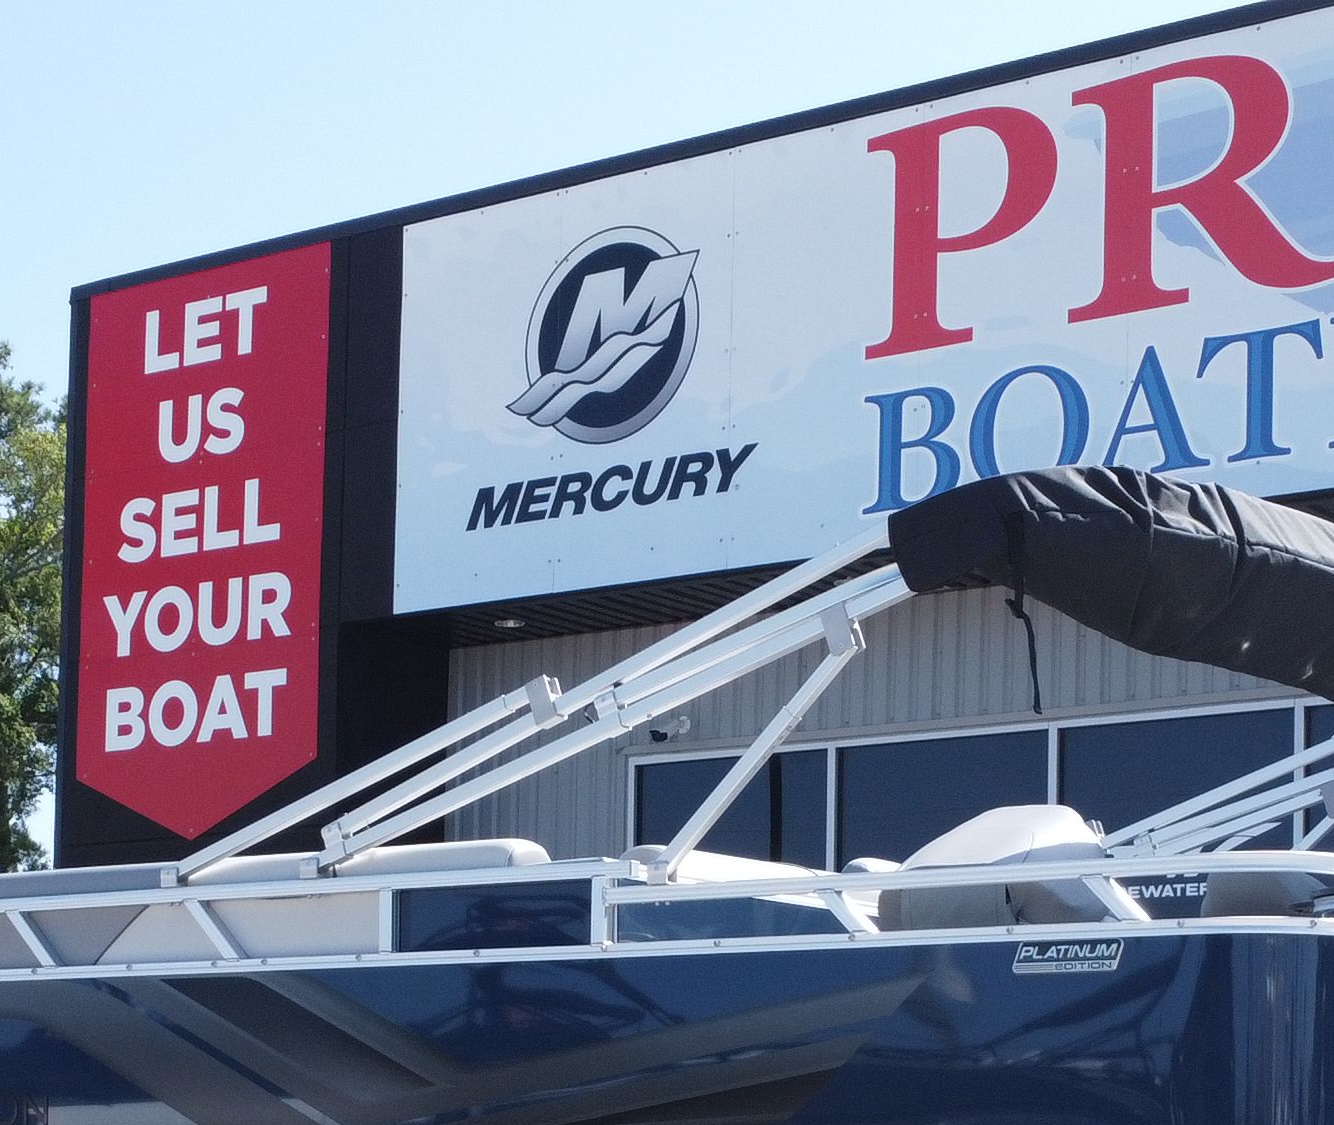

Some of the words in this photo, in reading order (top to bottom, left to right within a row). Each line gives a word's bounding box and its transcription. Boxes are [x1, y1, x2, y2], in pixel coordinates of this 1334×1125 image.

[144, 285, 268, 374] LET
[158, 387, 245, 462] US
[116, 478, 281, 563] SELL
[466, 443, 760, 531] MERCURY
[103, 571, 292, 657] YOUR
[105, 668, 287, 753] BOAT
[1020, 943, 1118, 959] PLATINUM
